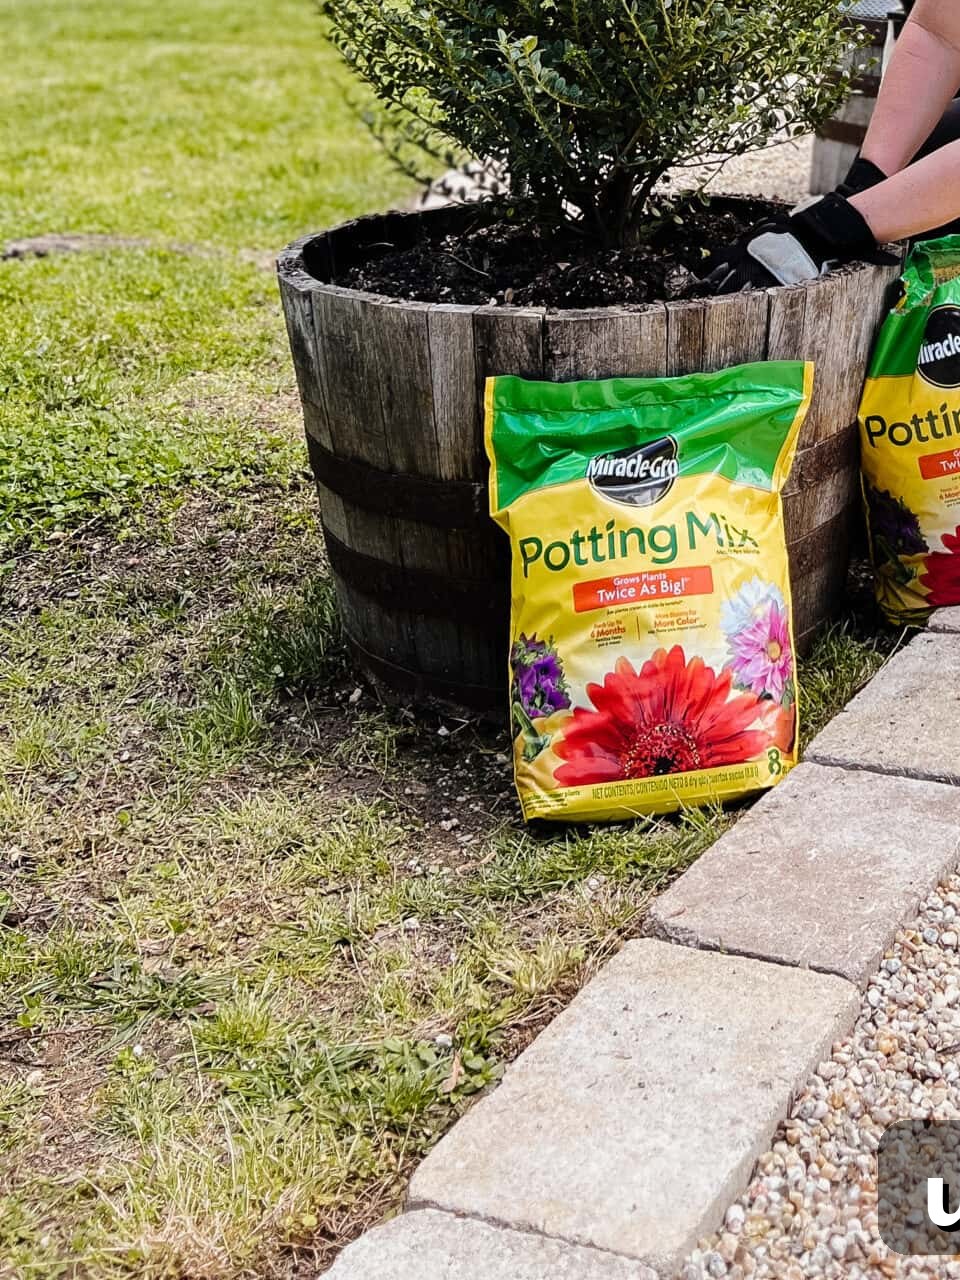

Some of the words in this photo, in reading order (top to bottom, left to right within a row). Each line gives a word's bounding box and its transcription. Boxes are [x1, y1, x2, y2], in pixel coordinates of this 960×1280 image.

[519, 519, 677, 578] Potting
[686, 511, 759, 549] Mix
[597, 586, 636, 602] Twice
[640, 583, 657, 597] As
[660, 577, 686, 594] Big!
[613, 576, 640, 586] Grows
[642, 572, 667, 582] Plants
[768, 748, 781, 775] 8
